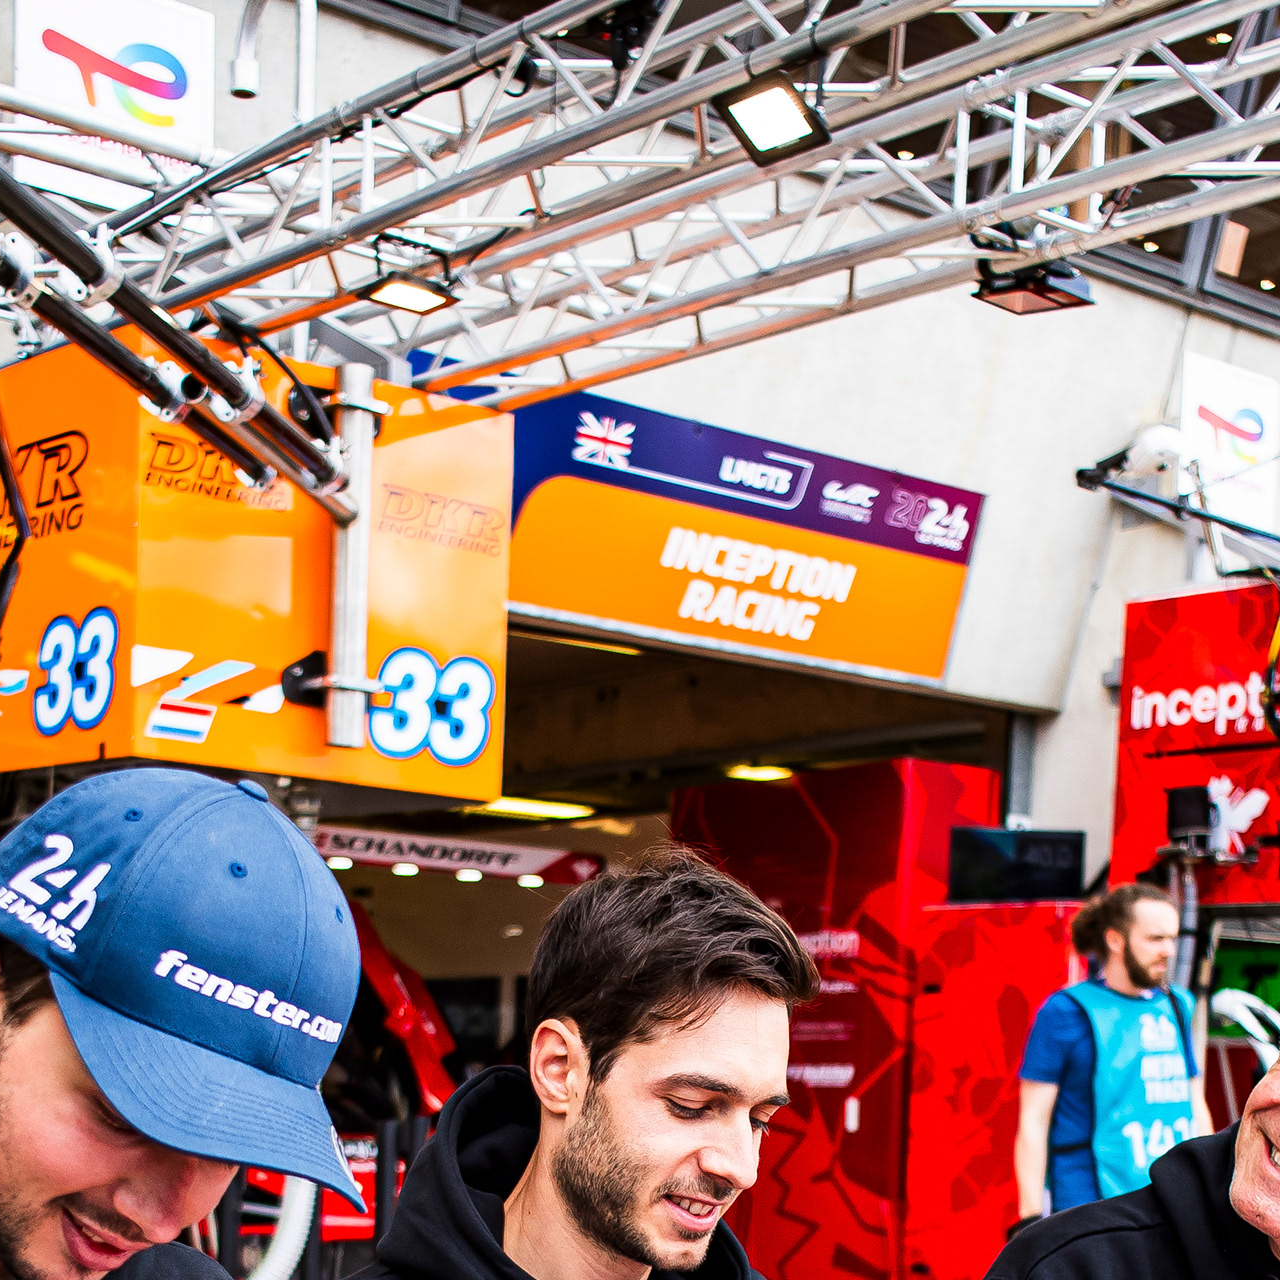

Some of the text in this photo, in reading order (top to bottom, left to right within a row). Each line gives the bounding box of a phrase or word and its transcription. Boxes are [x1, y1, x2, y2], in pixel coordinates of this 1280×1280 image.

[660, 526, 858, 603] INCEPTION
[678, 579, 821, 641] RACING
[34, 606, 119, 736] 33
[370, 646, 496, 766] 33
[1130, 671, 1267, 736] incept
[10, 834, 111, 931] 24h
[331, 834, 519, 866] SCHANDORFF
[9, 896, 75, 952] MANS
[154, 950, 342, 1043] fenster.com
